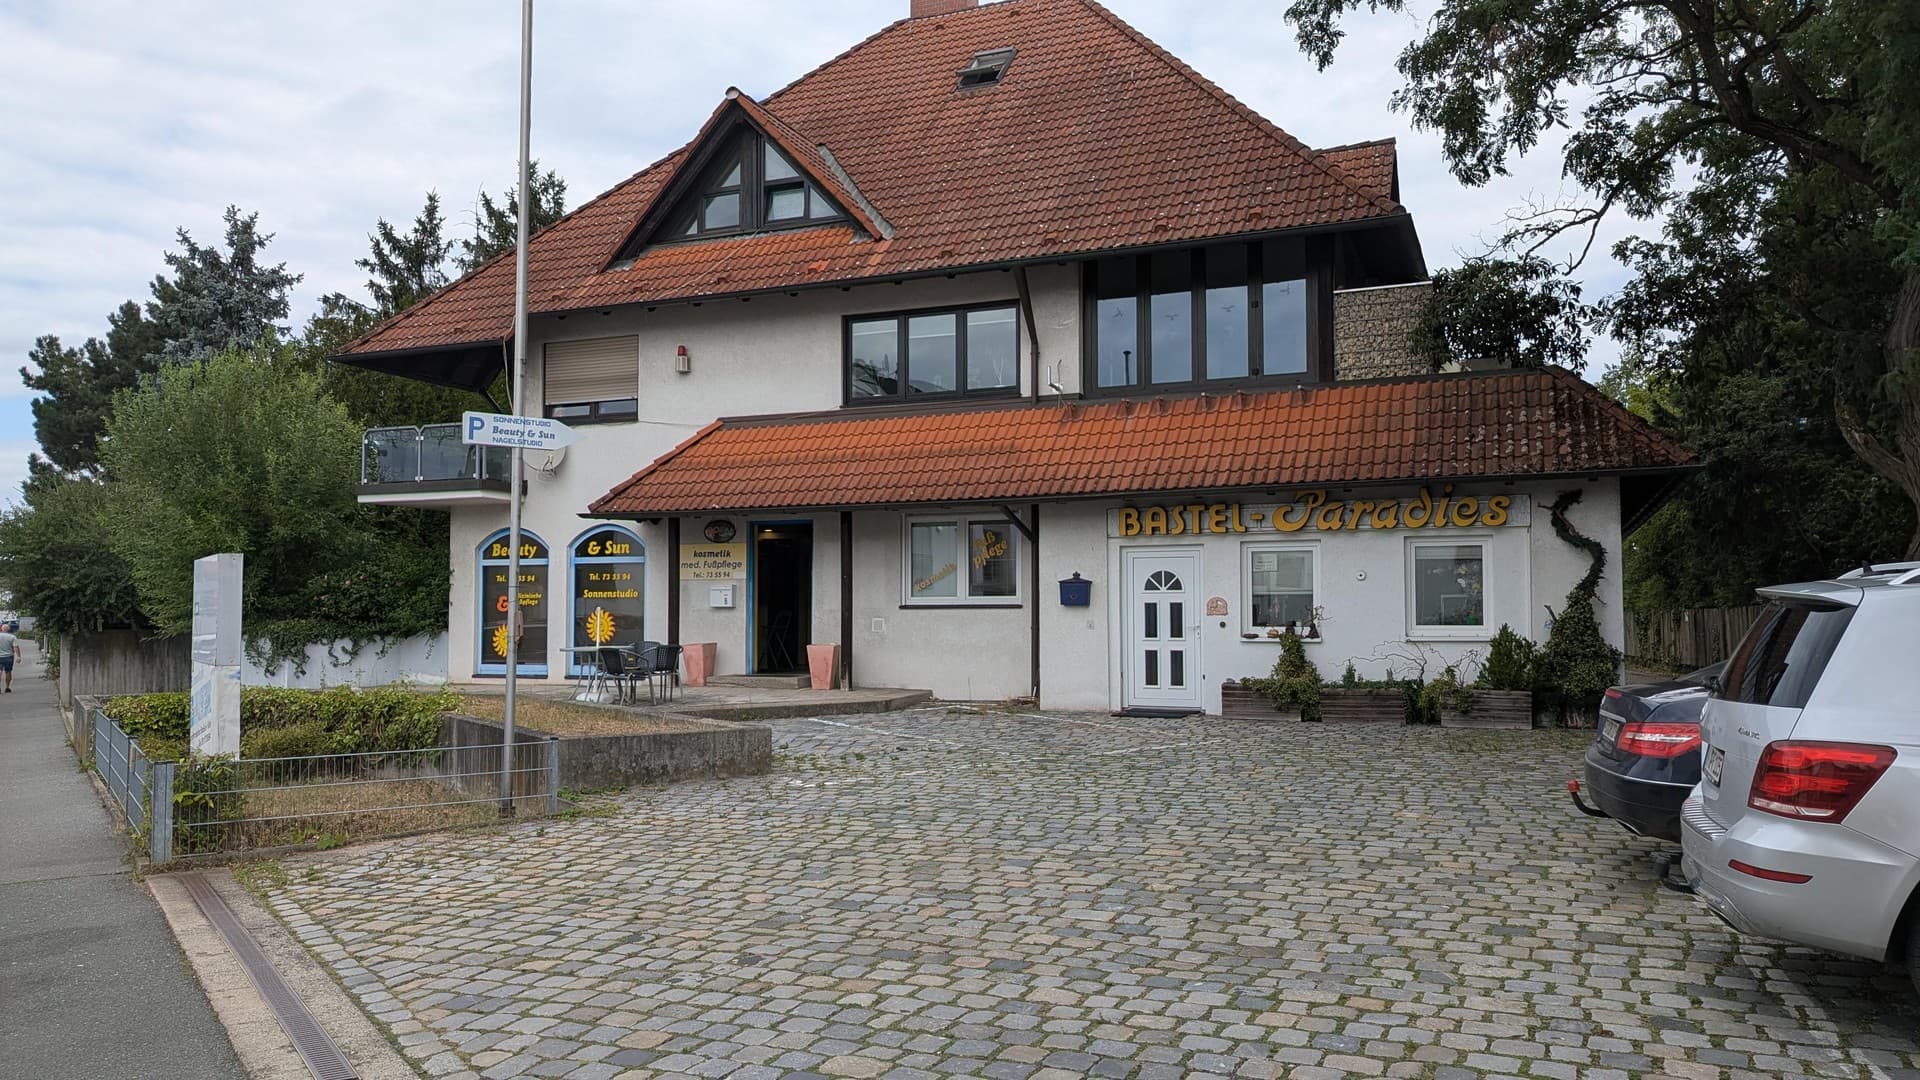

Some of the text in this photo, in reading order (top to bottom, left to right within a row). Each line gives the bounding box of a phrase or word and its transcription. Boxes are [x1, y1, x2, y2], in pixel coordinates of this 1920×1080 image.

[492, 416, 552, 428] SONNENSTUDIO
[468, 416, 485, 440] P
[492, 425, 556, 440] Beauty & Sun
[492, 436, 543, 447] NAGELSTUDIO
[492, 543, 538, 559] Beuty
[587, 540, 631, 555] & Sun
[693, 550, 732, 559] kosmetik
[680, 560, 743, 570] med. Fußpflege
[495, 574, 507, 583] Tel.
[588, 573, 632, 581] Tel. 73 55 94
[583, 588, 639, 599] Sonnenstudio
